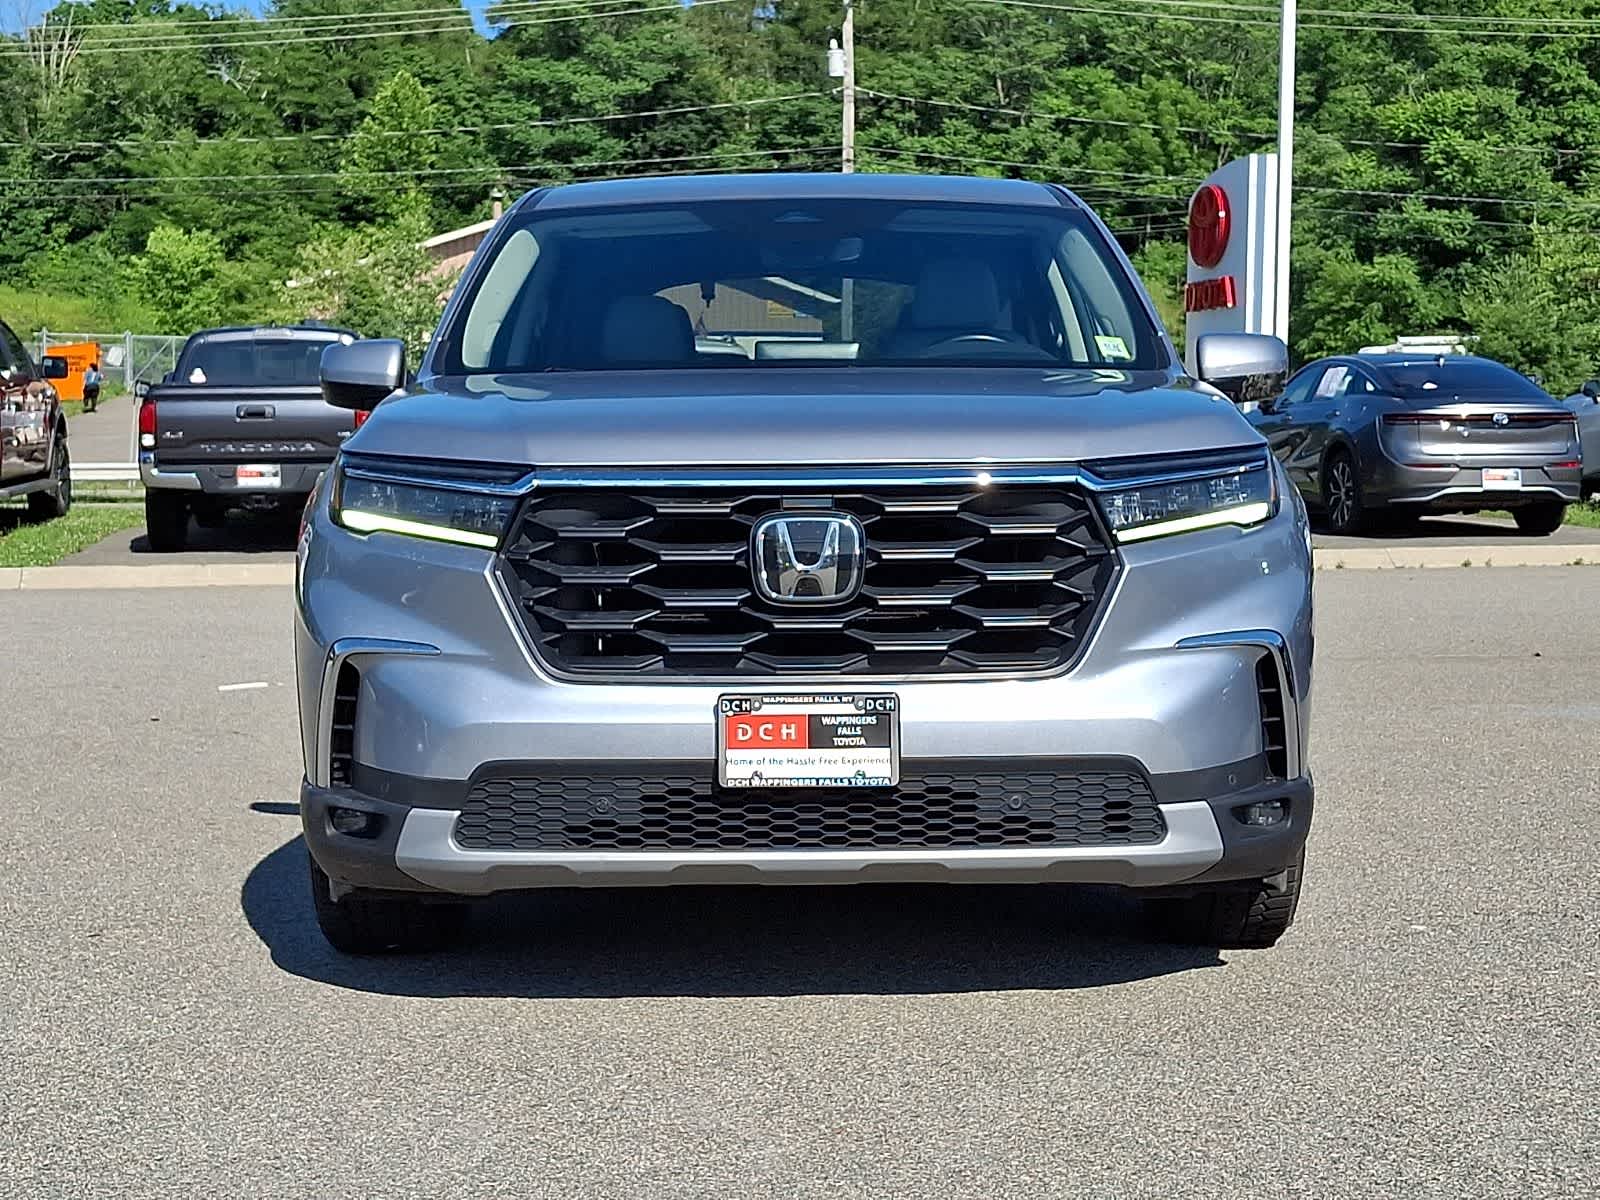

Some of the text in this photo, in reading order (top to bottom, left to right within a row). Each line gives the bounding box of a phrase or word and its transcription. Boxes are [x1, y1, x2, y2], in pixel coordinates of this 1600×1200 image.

[200, 442, 316, 453] TACOMA
[842, 695, 853, 703] NY
[722, 699, 751, 712] DCH
[866, 699, 895, 711] DCH
[821, 716, 877, 726] WAPPINGERS
[736, 723, 797, 742] DCH
[837, 726, 862, 736] FALLS
[832, 737, 866, 747] TOYOTA
[727, 757, 754, 766] Home
[756, 757, 765, 766] of
[768, 757, 784, 766] the
[786, 756, 816, 766] Hassle
[819, 756, 838, 765] Free
[727, 777, 891, 788] DCH WAPPINGERS FALLS TOYOTA
